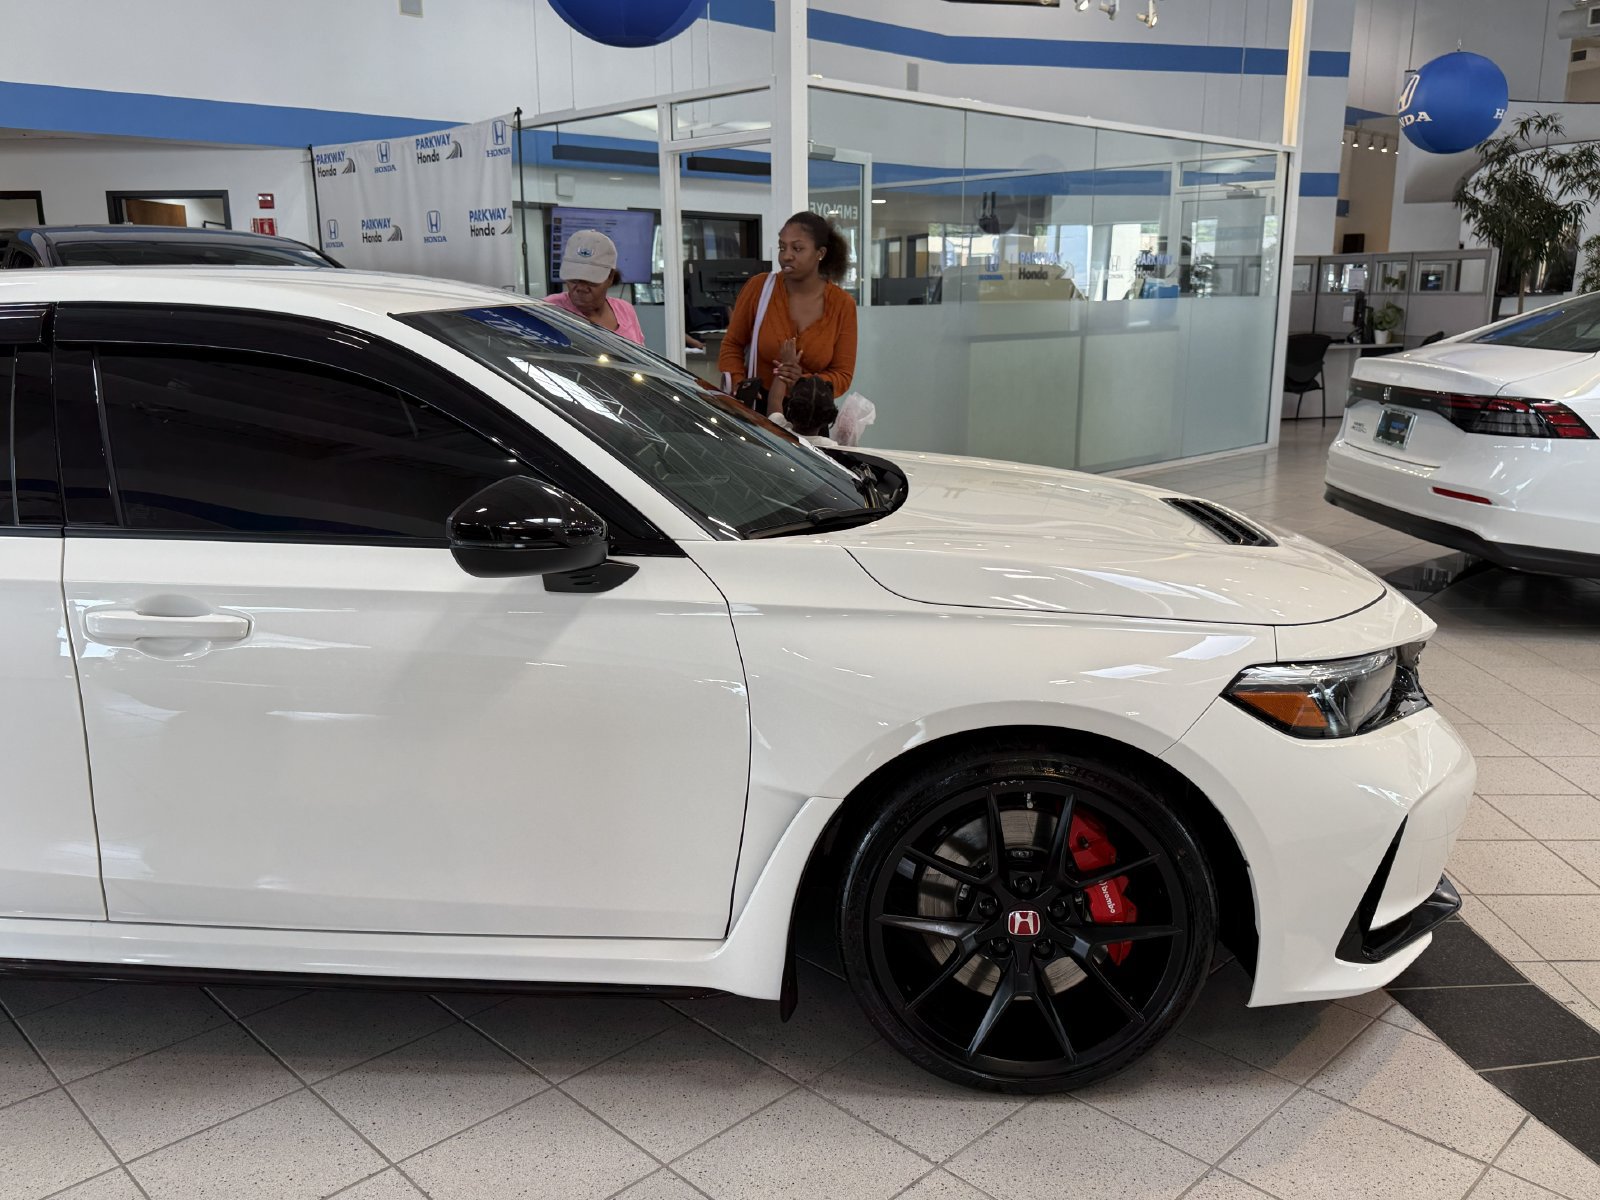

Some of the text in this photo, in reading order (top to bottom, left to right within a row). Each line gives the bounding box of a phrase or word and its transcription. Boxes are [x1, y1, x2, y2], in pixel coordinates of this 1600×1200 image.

[415, 133, 451, 150] PARKWAY
[315, 150, 346, 165] PARKWAY
[416, 149, 440, 164] Honda
[486, 147, 511, 158] HONDA
[317, 165, 337, 178] Honda
[374, 164, 397, 174] HONDA
[469, 207, 507, 222] PARKWAY
[361, 217, 391, 230] PARKWAY
[470, 222, 496, 237] Honda
[362, 231, 382, 243] Honda
[423, 235, 447, 244] HONDA
[1018, 266, 1049, 280] Honda
[1101, 885, 1116, 914] brembo
